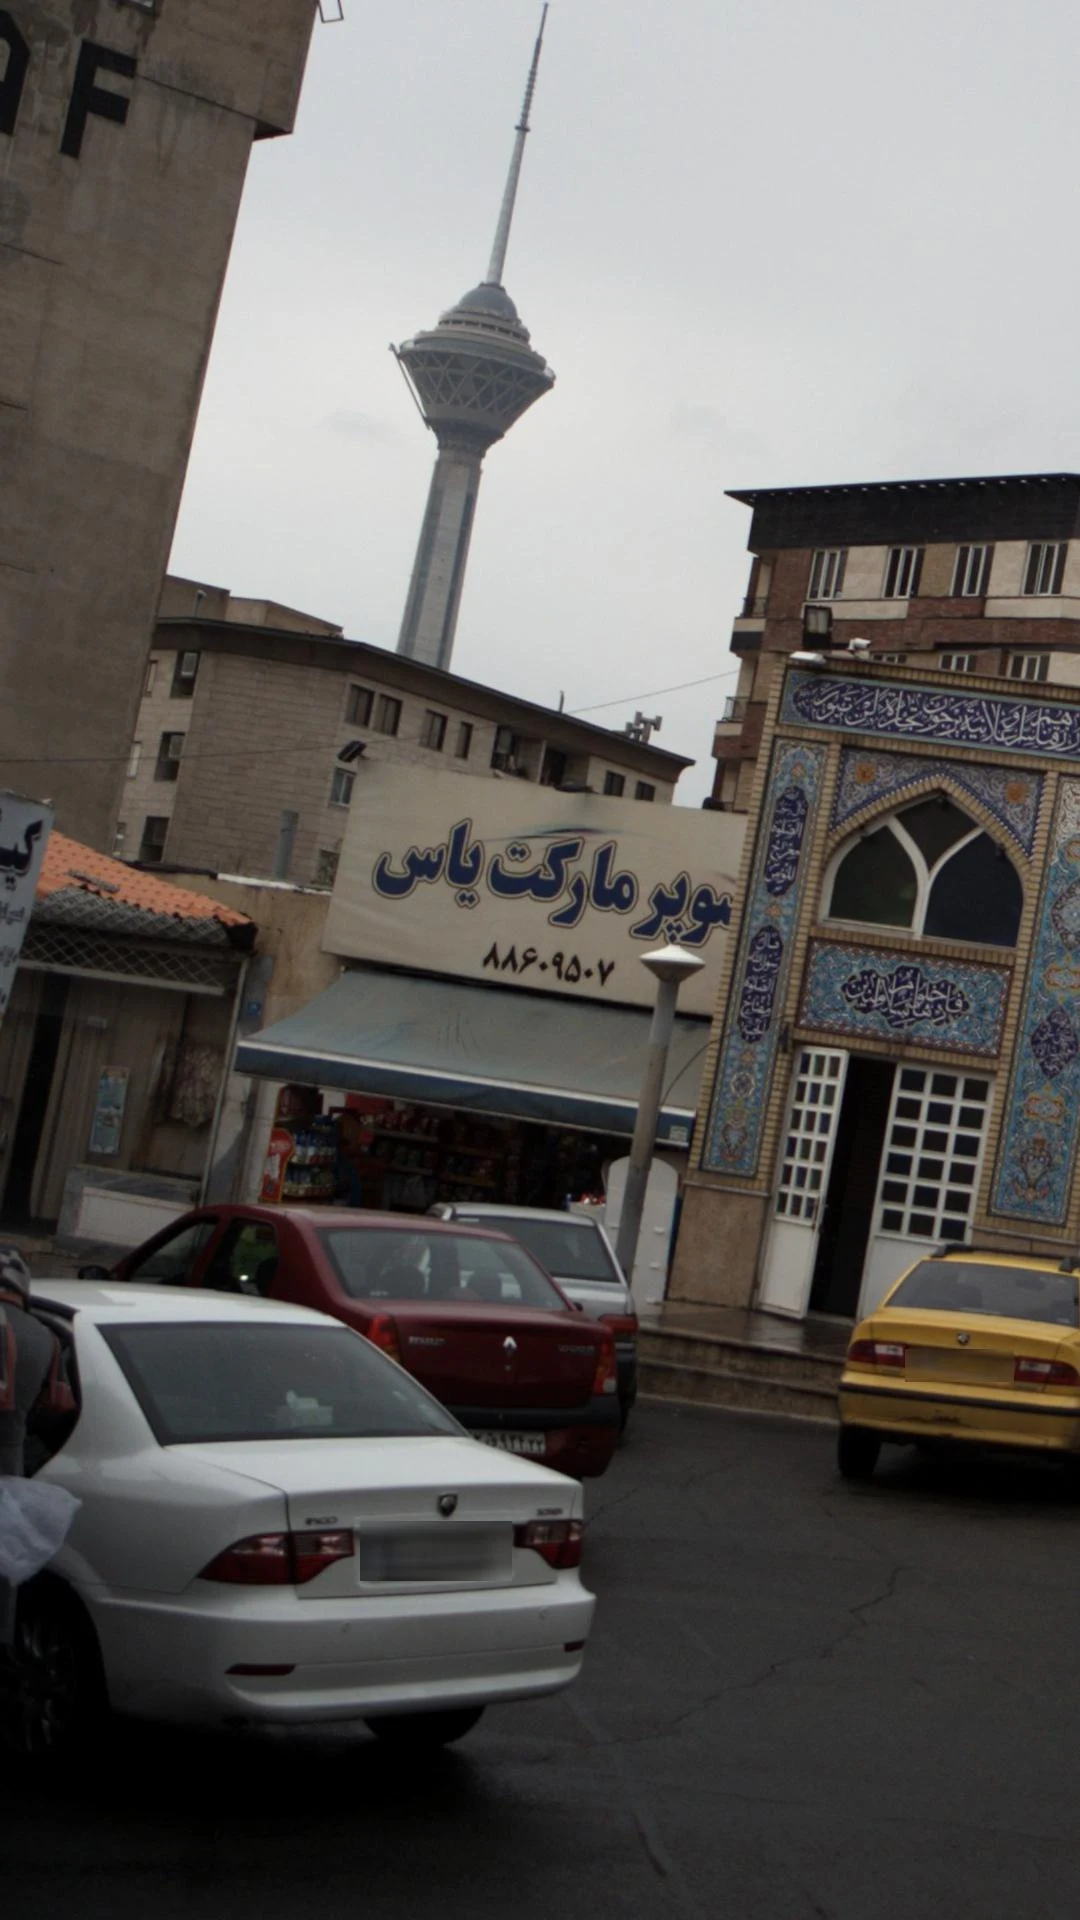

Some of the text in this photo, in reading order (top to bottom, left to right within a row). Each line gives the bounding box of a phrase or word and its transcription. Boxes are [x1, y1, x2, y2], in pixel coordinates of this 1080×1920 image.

[373, 818, 484, 908] یاس
[487, 837, 639, 928] مارکت
[482, 941, 615, 987] ۸۸۶۰۹۵۰۷
